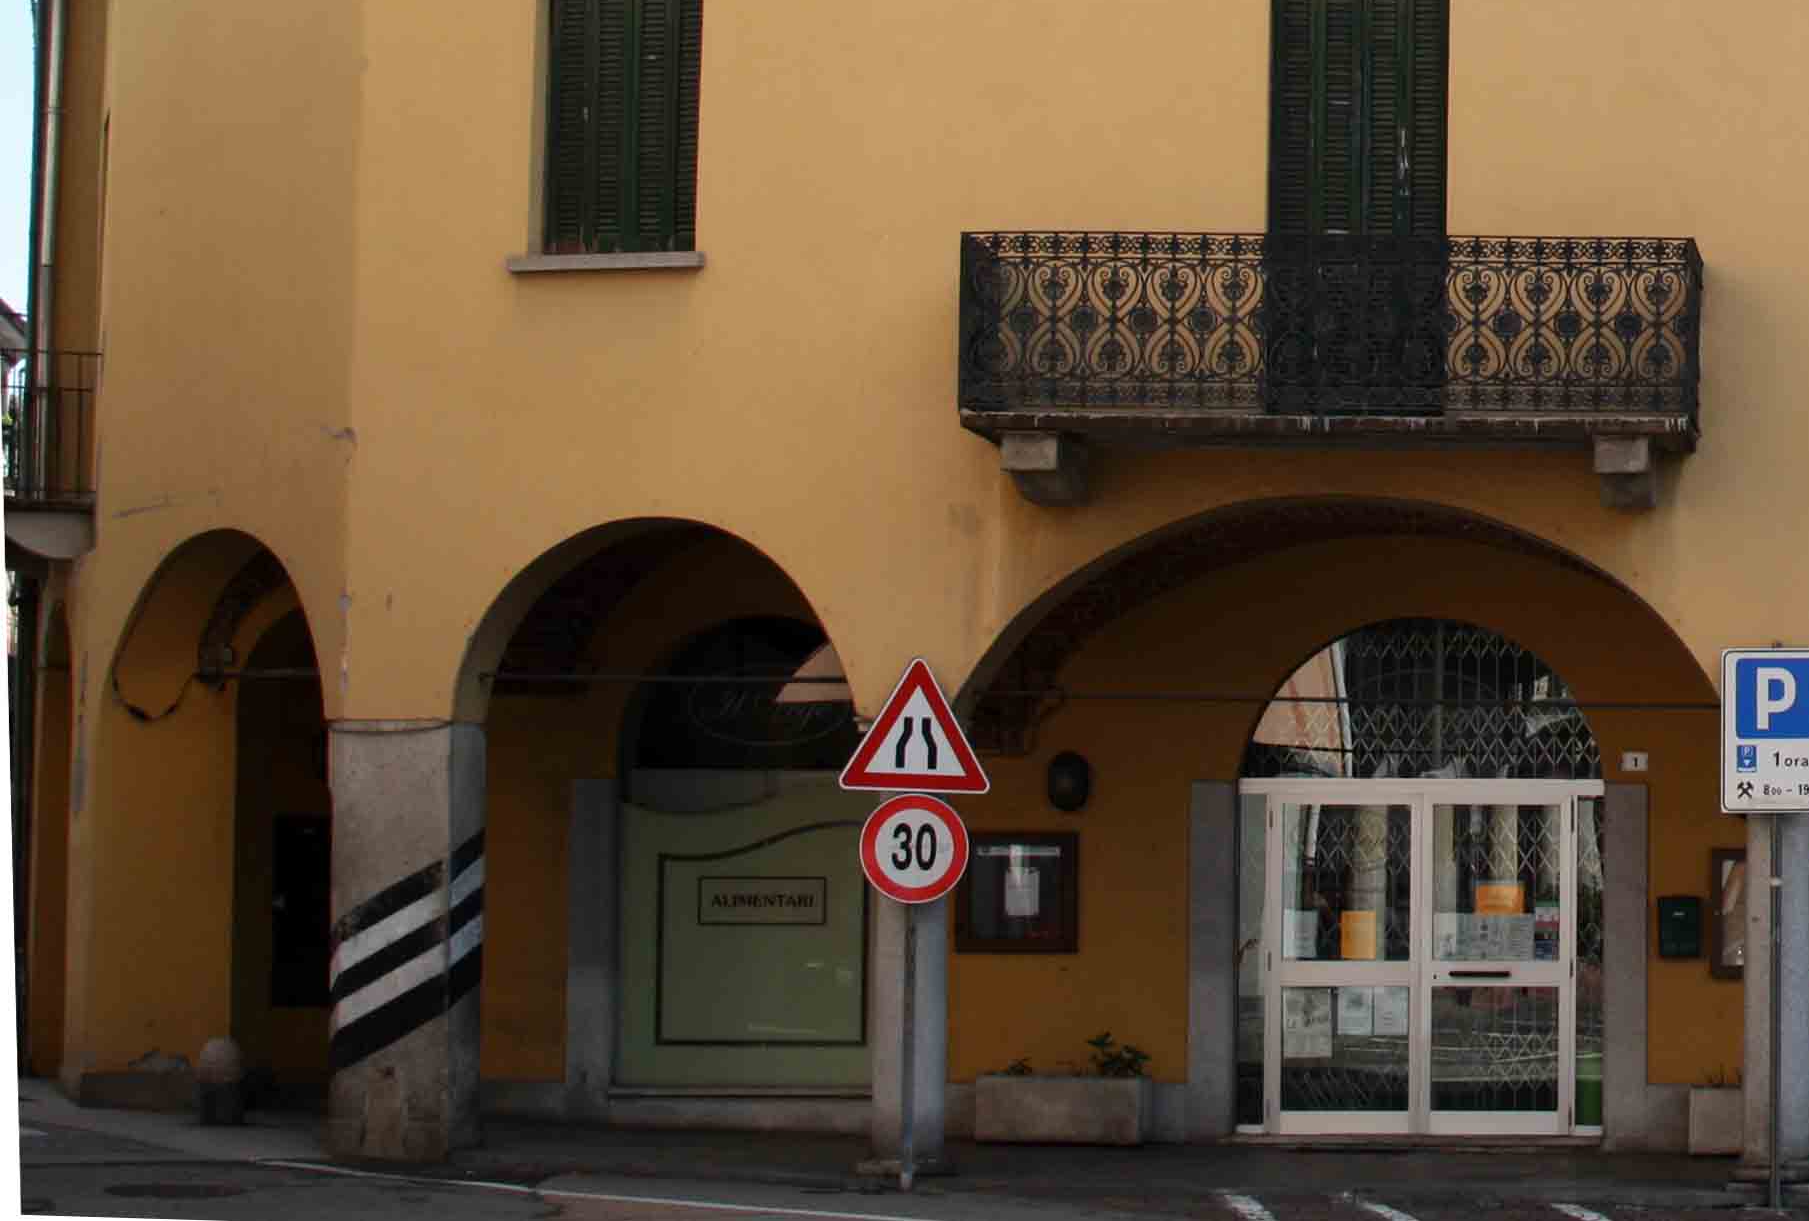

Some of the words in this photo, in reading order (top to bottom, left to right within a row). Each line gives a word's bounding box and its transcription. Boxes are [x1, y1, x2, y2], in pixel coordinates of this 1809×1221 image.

[1756, 666, 1796, 730] P
[1784, 757, 1809, 767] ora
[892, 822, 937, 871] 30
[711, 893, 815, 908] ALIMENTARI
